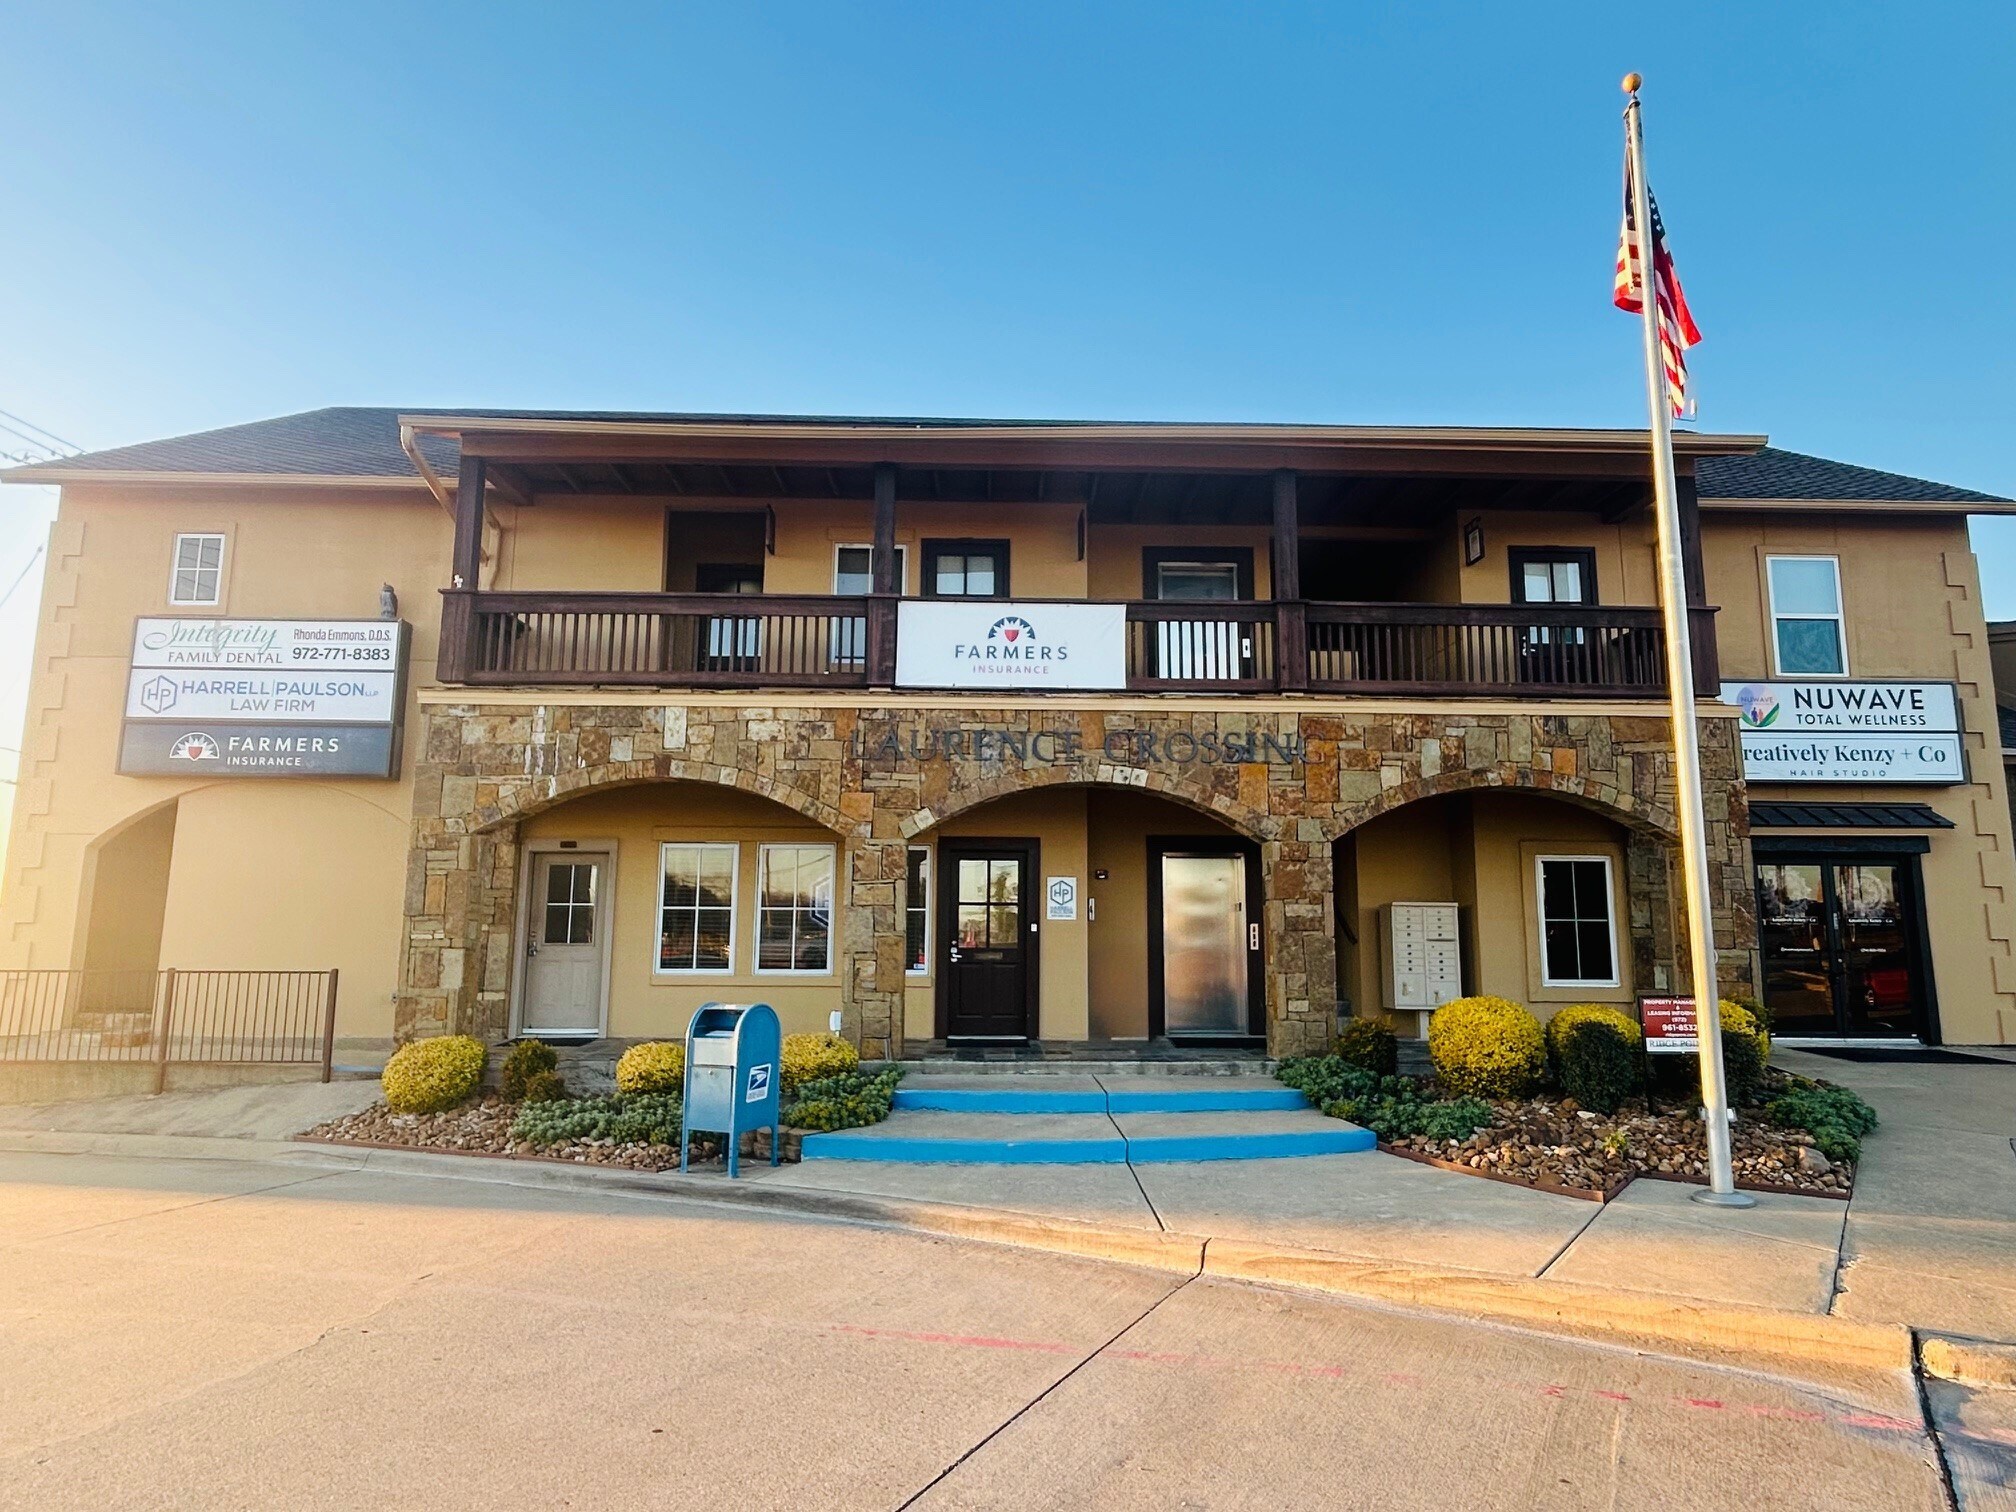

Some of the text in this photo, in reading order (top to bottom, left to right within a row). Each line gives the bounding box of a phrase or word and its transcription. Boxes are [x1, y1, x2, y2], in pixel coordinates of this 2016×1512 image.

[143, 620, 278, 652] Integrity
[293, 628, 327, 641] Rhonda
[368, 629, 392, 642] D.D.S.
[168, 651, 283, 664] FAMILY DENTAL
[292, 647, 390, 660] 972-771-8383
[954, 644, 1068, 660] FARMERS
[972, 664, 1050, 675] INSURANCE
[181, 680, 270, 695] HARRELL
[276, 681, 365, 697] PAULSON
[230, 698, 315, 712] LAW FIRM
[1793, 687, 1925, 710] NUWAVE
[1796, 713, 1927, 726] TOTAL WELLNESS
[228, 736, 340, 752] FARMERS
[849, 728, 1326, 764] LAURENCE CROSSING
[226, 756, 302, 767] INSURANCE
[1744, 744, 1830, 765] reatively
[1835, 745, 1896, 766] Kenzy
[1918, 745, 1947, 763] Co
[1790, 769, 1887, 777] HAIR STUDIO
